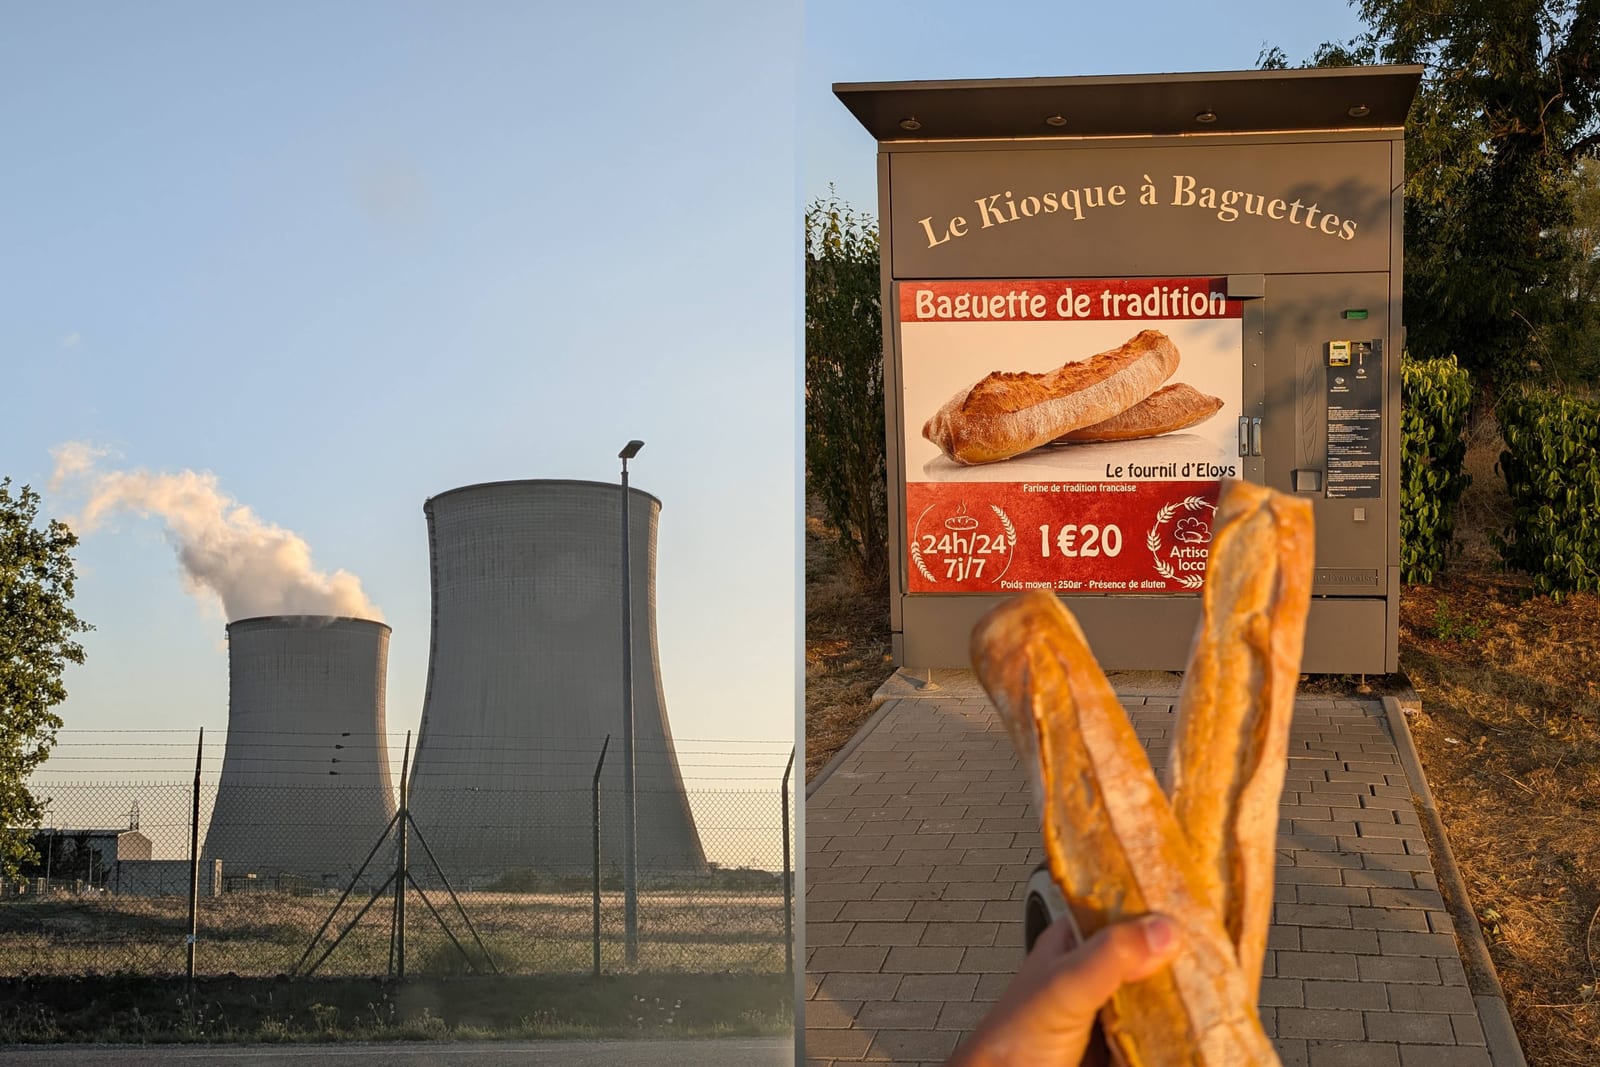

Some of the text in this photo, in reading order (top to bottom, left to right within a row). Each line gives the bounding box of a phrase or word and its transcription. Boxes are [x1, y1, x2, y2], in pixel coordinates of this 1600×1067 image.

[918, 173, 1358, 249] Le Kiosque à Baguettes
[915, 286, 1226, 320] Baguette de tradition
[1106, 462, 1236, 478] Le fournil d'Eloys
[1023, 483, 1049, 493] Farine
[1050, 483, 1061, 493] de
[1062, 483, 1097, 492] tradition
[922, 531, 1007, 555] 24h/24
[1038, 523, 1123, 558] 1€20
[1169, 545, 1209, 559] Artisa
[943, 556, 987, 582] 7j/7
[1000, 580, 1024, 590] Poids
[1025, 580, 1052, 590] moyen
[1058, 580, 1082, 590] 250gr
[1089, 579, 1127, 589] Présence
[1128, 579, 1139, 589] de
[1140, 579, 1166, 589] gluten
